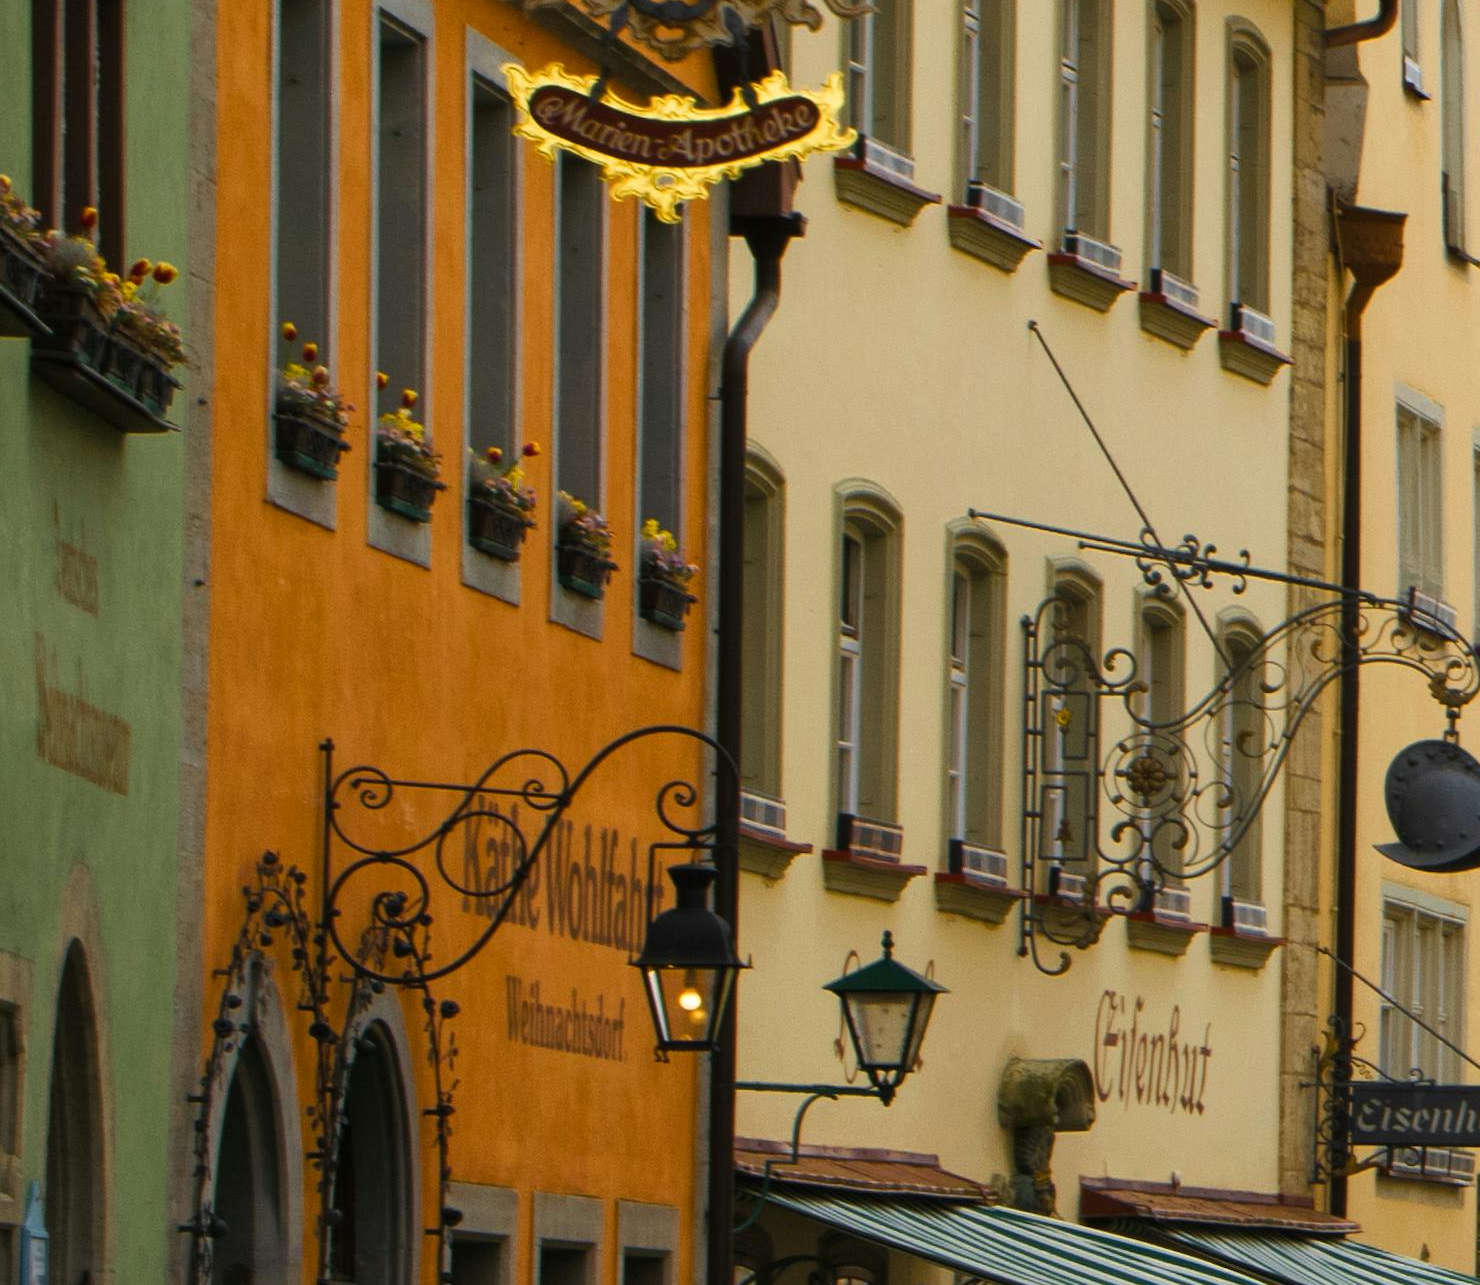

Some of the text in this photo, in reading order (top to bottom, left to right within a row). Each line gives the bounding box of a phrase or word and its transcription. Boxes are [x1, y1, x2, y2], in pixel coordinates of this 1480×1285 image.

[536, 97, 814, 164] Marien-Apotheke
[543, 814, 665, 956] Wohlfaht
[506, 975, 627, 1063] Weihnachtsdorf
[1094, 989, 1212, 1116] Eisenhut
